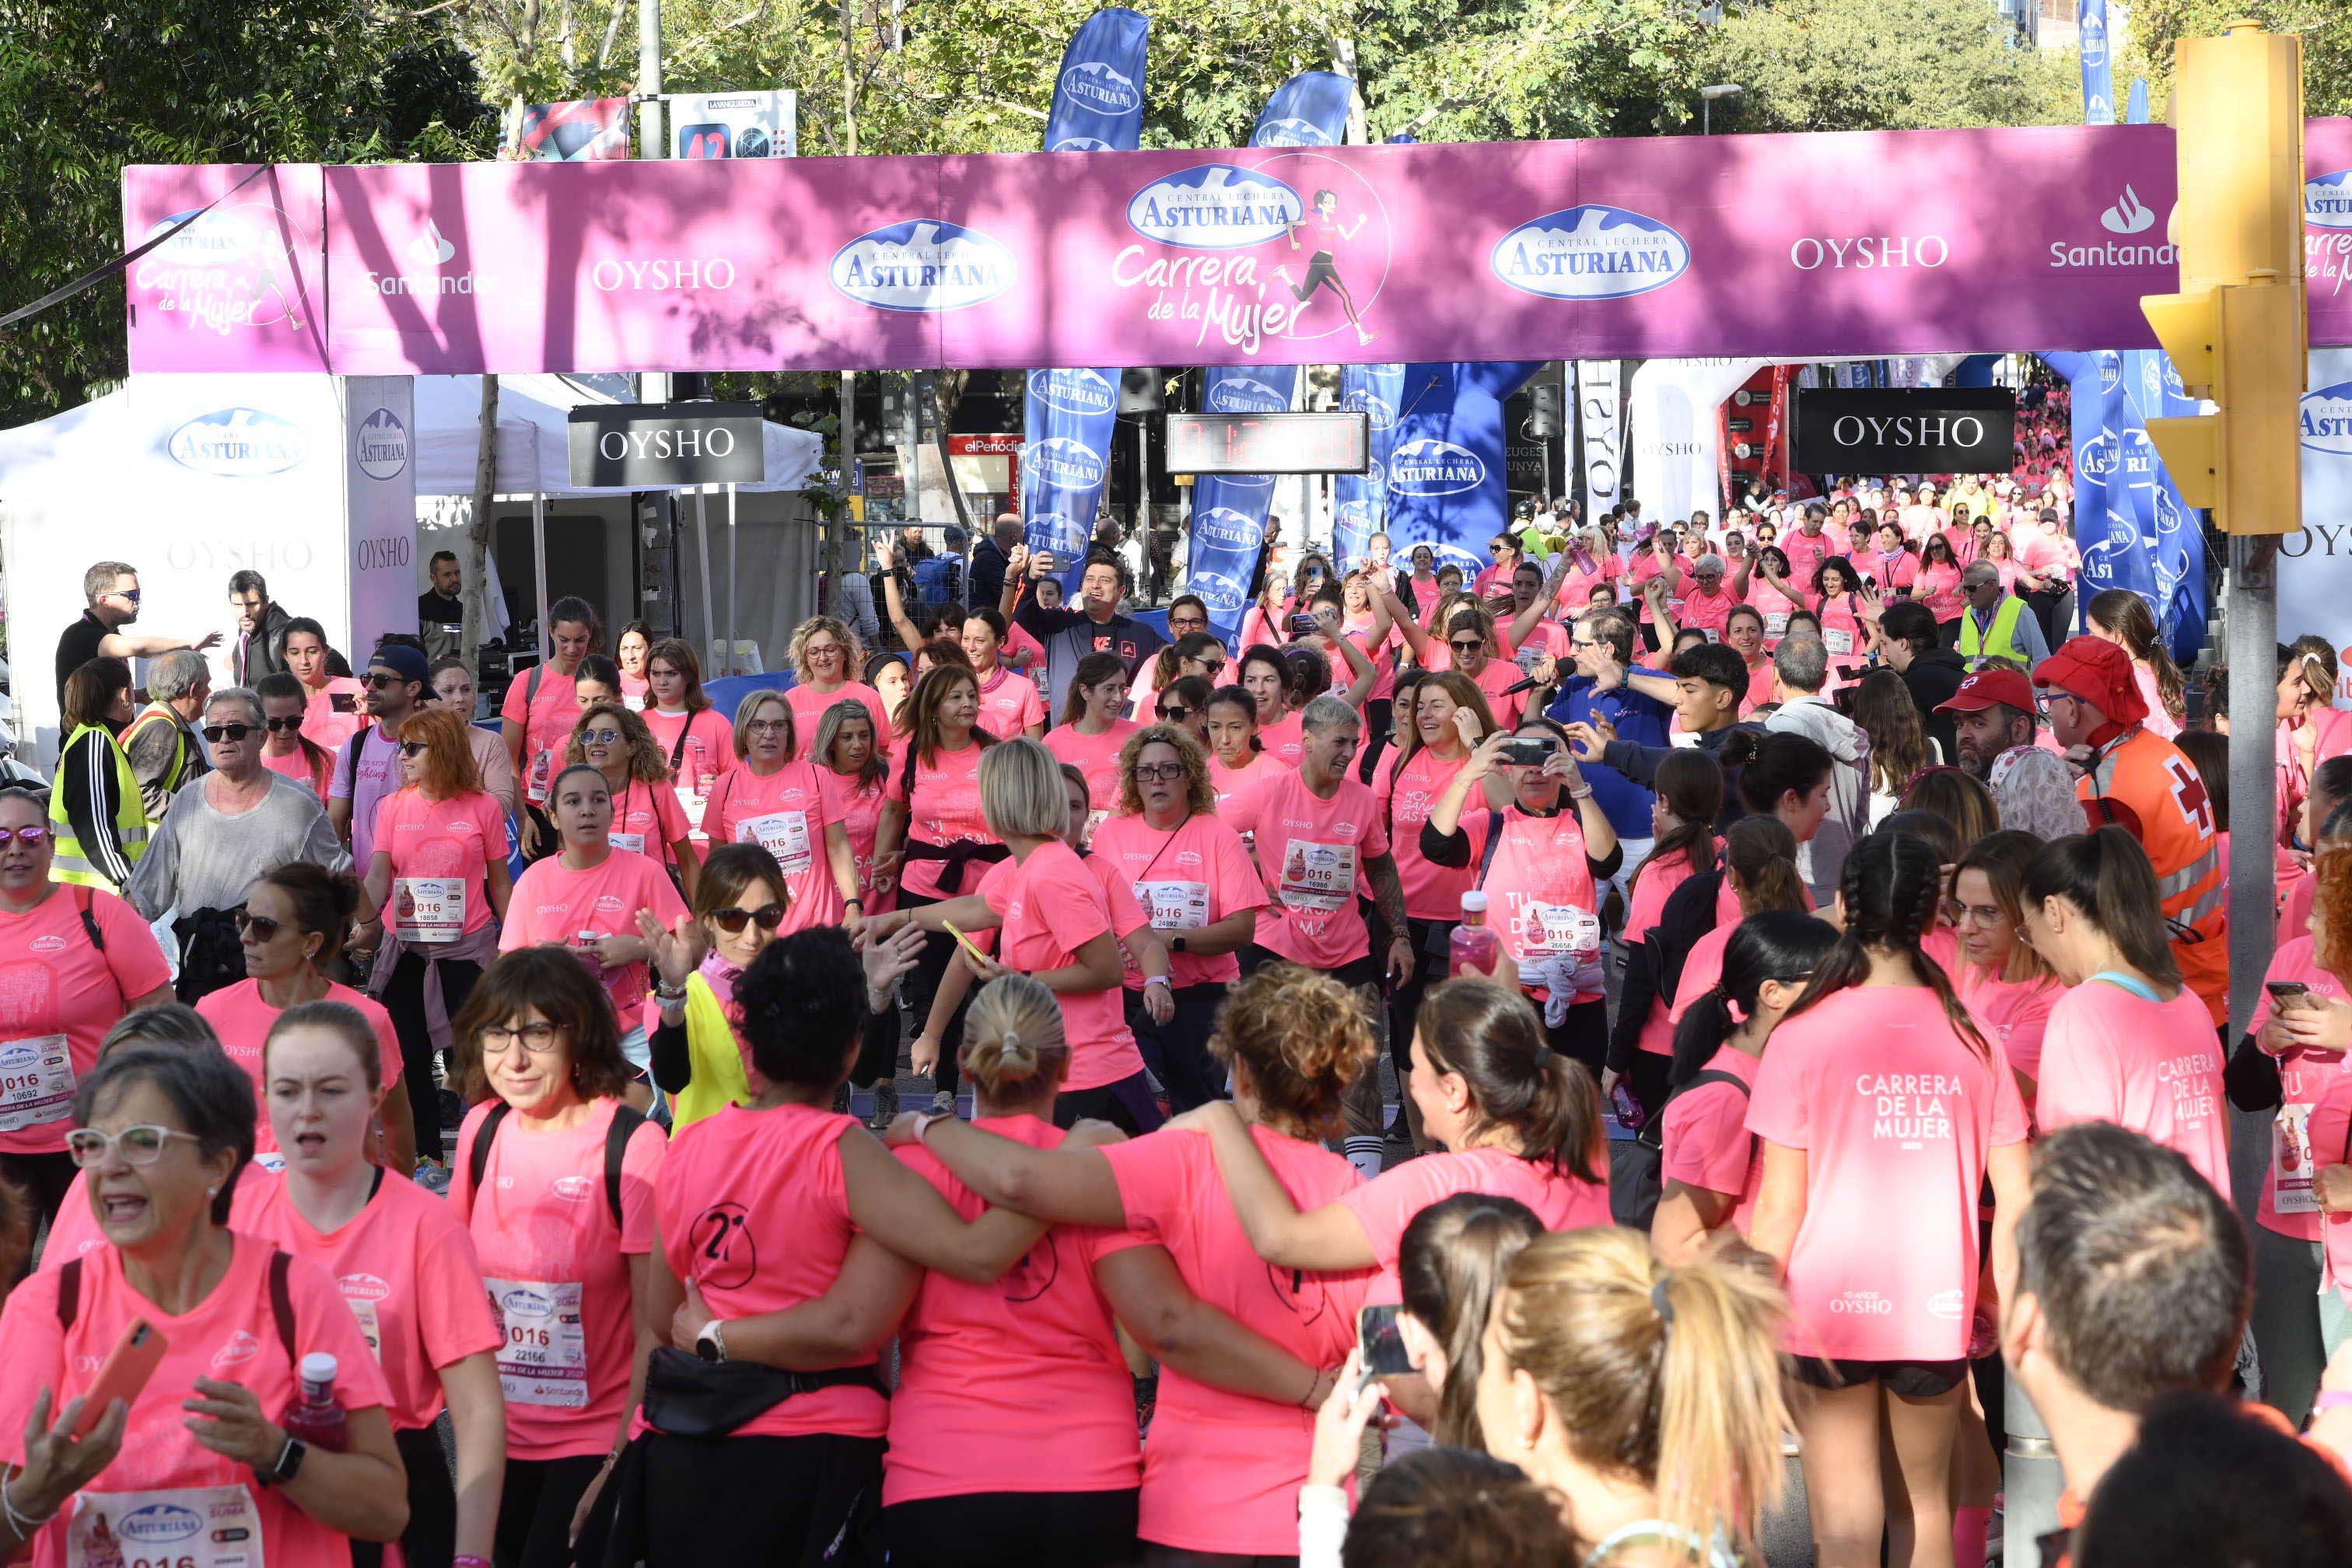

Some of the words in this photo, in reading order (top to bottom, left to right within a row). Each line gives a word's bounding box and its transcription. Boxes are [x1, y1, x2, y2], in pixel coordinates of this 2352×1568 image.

[1067, 73, 1132, 108] ASTURIANA
[709, 100, 717, 108] LA
[717, 99, 755, 107] VANGUARDIA
[1167, 193, 1223, 202] CENTRAL
[1229, 191, 1285, 201] LECHERA
[1140, 196, 1290, 228] ASTURIANA
[1537, 236, 1600, 250] CENTRAL
[1605, 235, 1669, 247] LECHERA
[1790, 235, 1949, 270] OYSHO
[2305, 233, 2352, 256] arre
[871, 250, 931, 261] CENTRAL
[1111, 243, 1259, 288] Carrera
[1507, 241, 1675, 278] ASTURIANA
[2322, 255, 2336, 278] la
[136, 261, 227, 290] Carrera
[593, 257, 736, 291] OYSHO
[845, 254, 999, 288] ASTURIANA
[366, 270, 500, 296] Santander
[158, 292, 176, 311] de
[1147, 289, 1174, 320] de
[1181, 289, 1200, 320] la
[1195, 282, 1313, 355] Mujer
[1037, 375, 1109, 408] ASTURIANA
[1216, 390, 1282, 412] ASTURIANA
[1832, 415, 1984, 448] OYSHO
[359, 439, 406, 463] ASTURIANA
[600, 428, 736, 461] OYSHO
[1031, 449, 1098, 482] ASTURIANA
[1390, 462, 1478, 484] ASTURIANA
[1400, 458, 1433, 467] CENTRAL
[166, 541, 313, 572] OYSHO
[357, 536, 410, 571] OYSHO
[920, 772, 948, 781] OYSHO
[1404, 772, 1431, 782] OYSHO
[1405, 789, 1433, 802] HOY
[395, 823, 425, 831] OYSHO
[1283, 818, 1313, 829] OYSHO
[1398, 810, 1419, 822] LAS
[761, 838, 786, 850] 016
[1123, 852, 1153, 861] OYSHO
[1307, 869, 1332, 880] 016
[417, 903, 442, 912] 016
[1156, 907, 1181, 918] 016
[1548, 929, 1573, 940] 016
[2156, 1053, 2216, 1083] CARRERA
[5, 1073, 39, 1090] 016
[1856, 1073, 1963, 1096] CARRERA
[2172, 1078, 2191, 1101] DE
[2193, 1075, 2211, 1097] LA
[12, 1089, 38, 1101] 10692
[1877, 1096, 1906, 1118] DE
[1915, 1095, 1945, 1117] LA
[1872, 1118, 1951, 1140] MUJER
[1829, 1299, 1893, 1314] OYSHO
[511, 1326, 550, 1346] 016
[537, 1368, 565, 1377] MUJER
